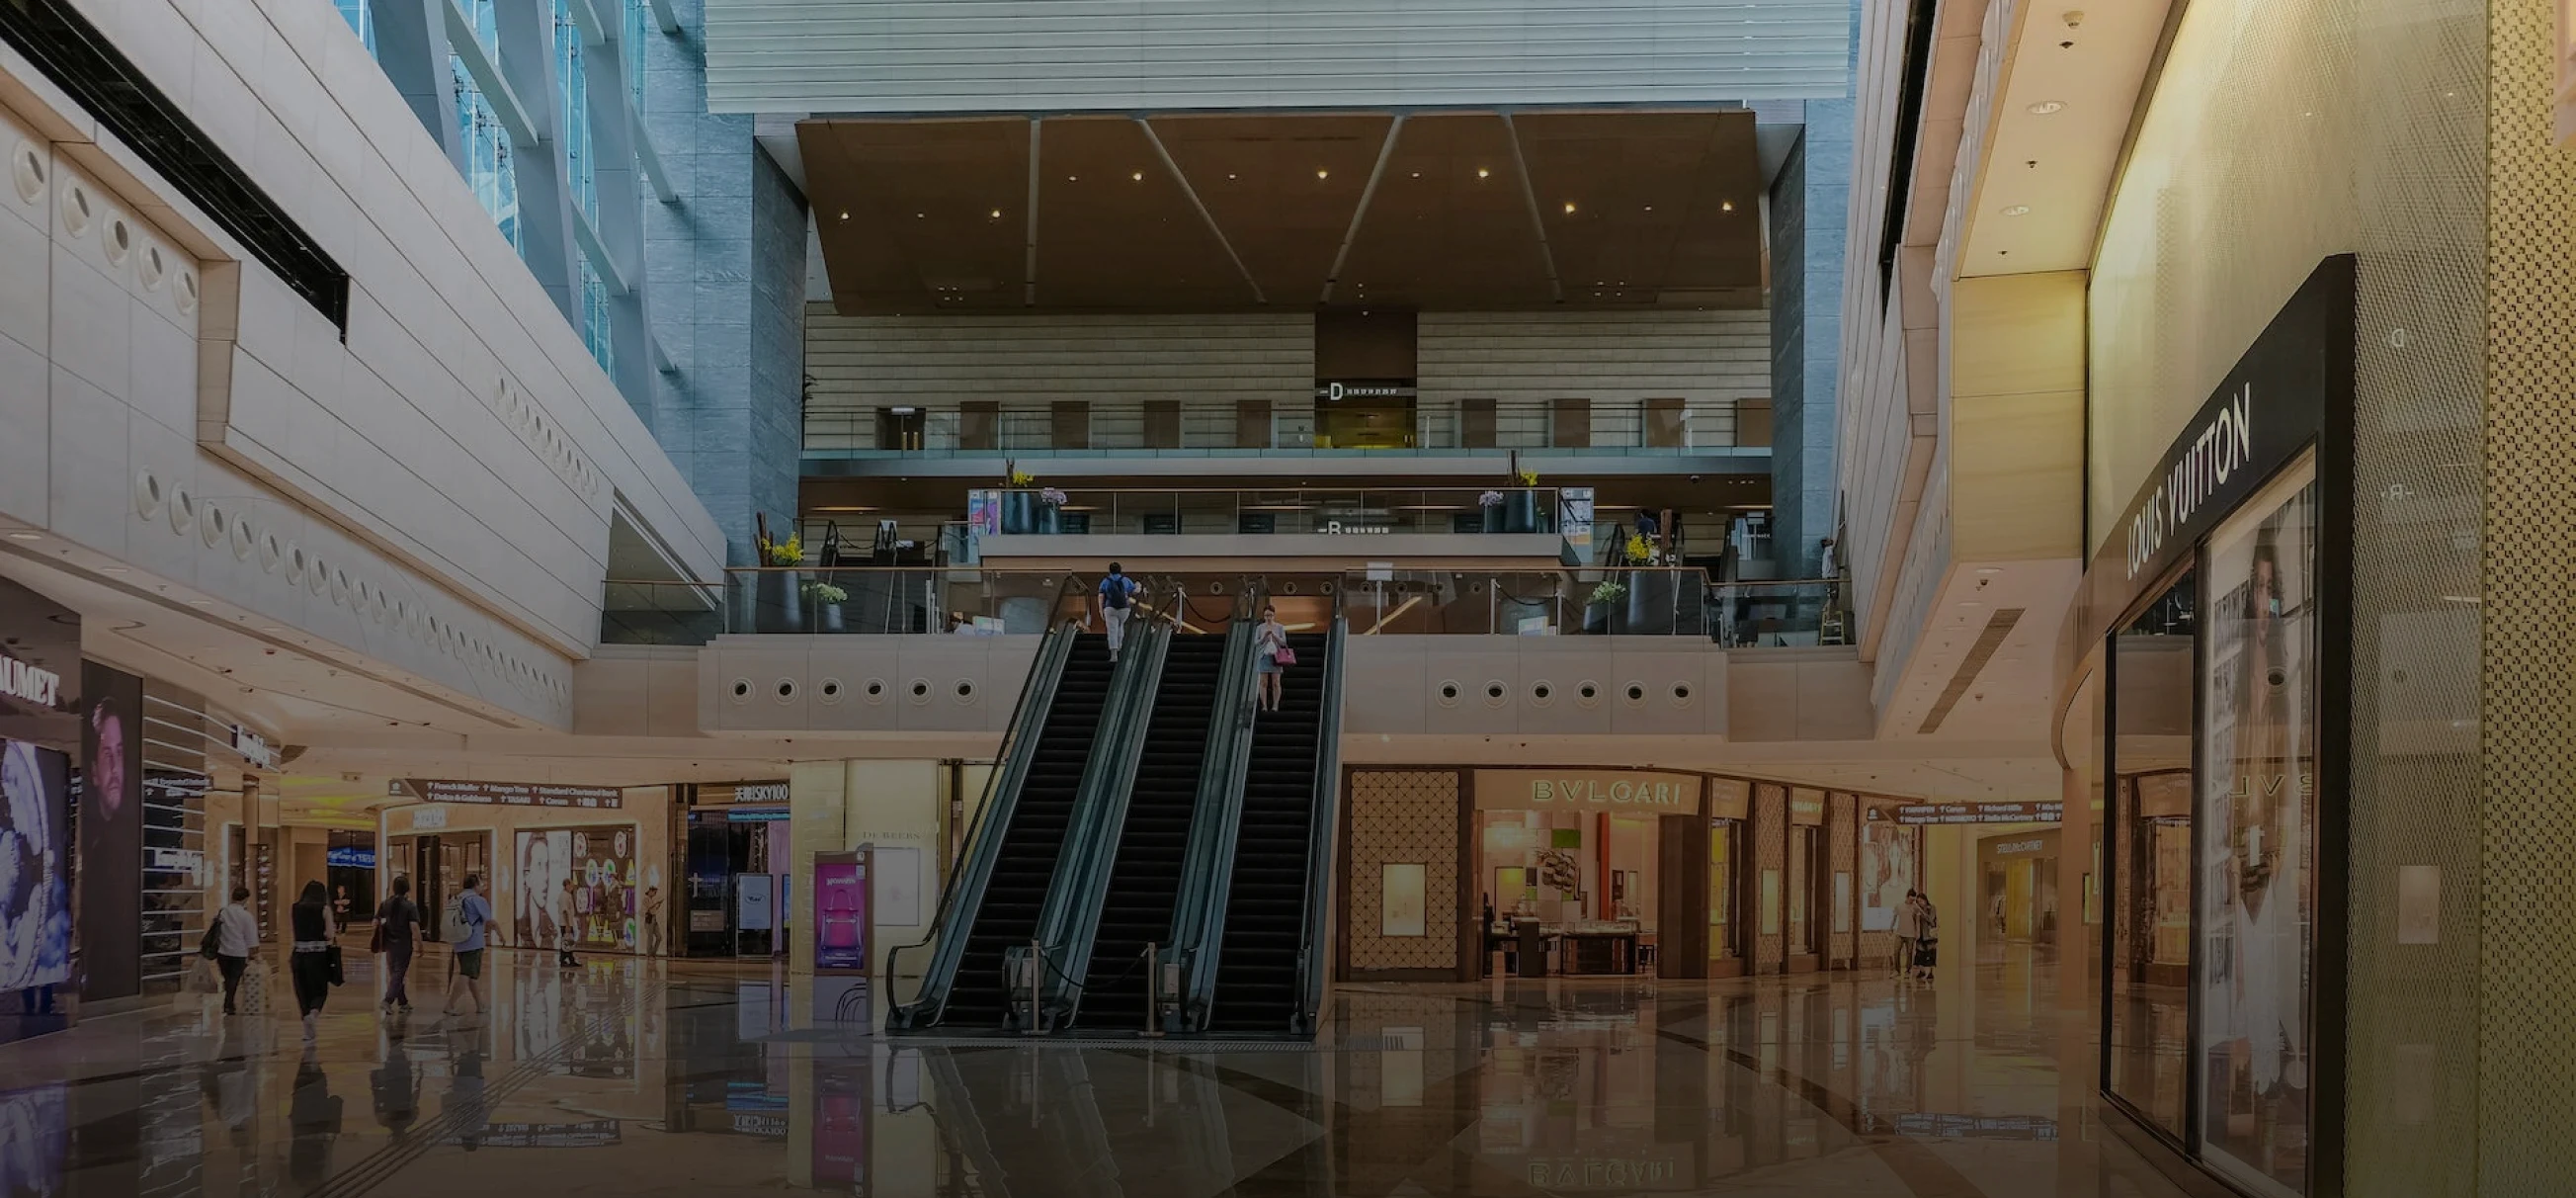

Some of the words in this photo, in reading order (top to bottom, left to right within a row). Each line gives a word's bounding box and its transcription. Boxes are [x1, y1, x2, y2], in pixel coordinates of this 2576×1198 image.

[1330, 382, 1344, 400] D
[2127, 485, 2162, 581] LOUIS
[2167, 381, 2251, 537] VUITTON
[0, 653, 59, 706] UMET
[1533, 779, 1681, 805] BVLGARI
